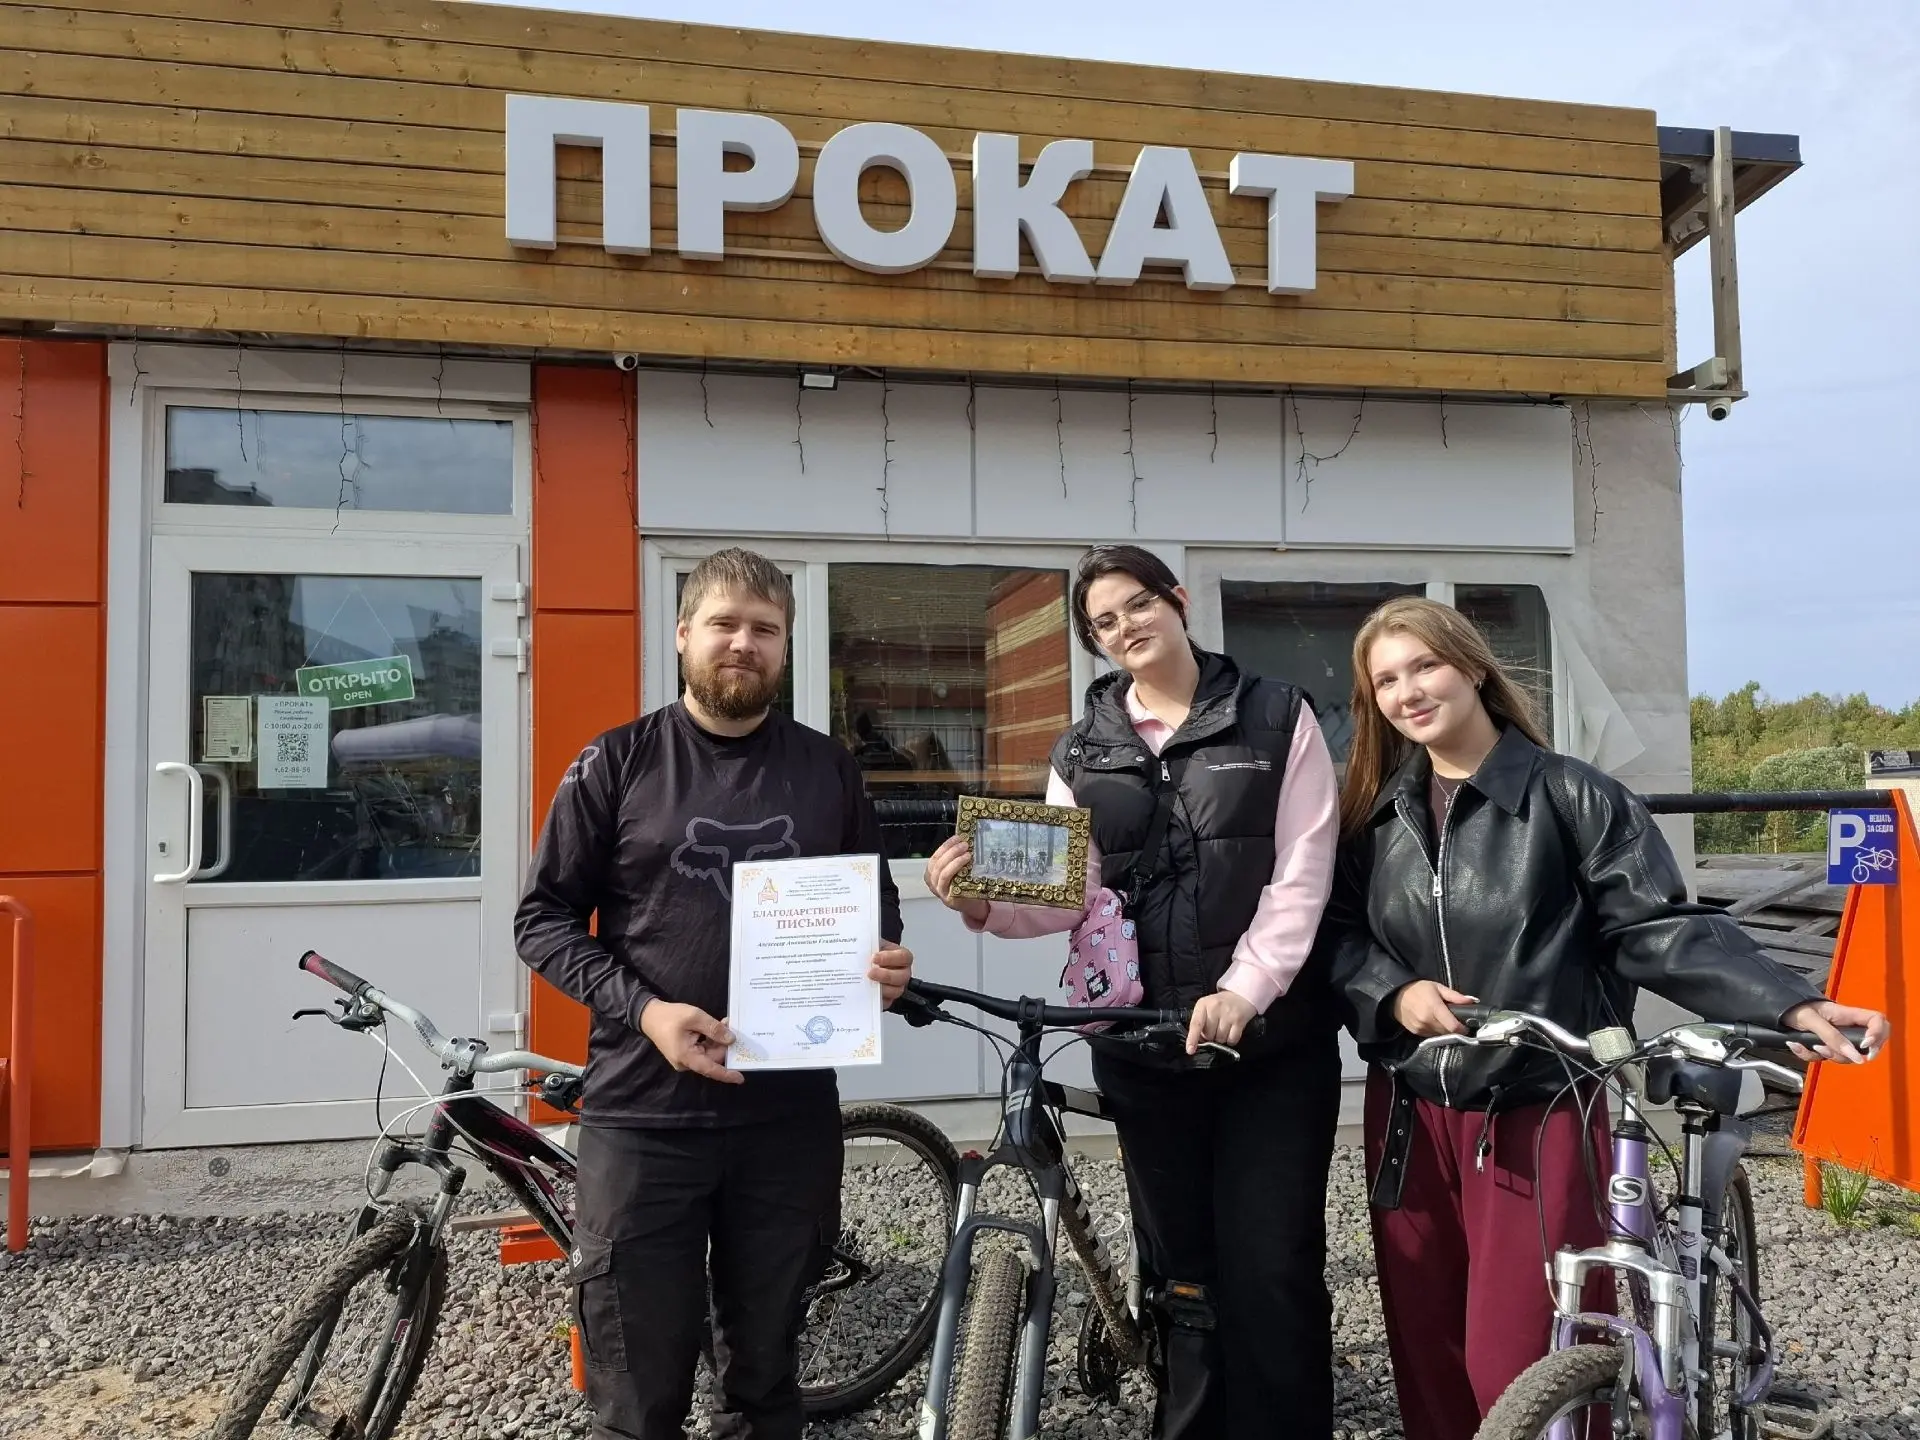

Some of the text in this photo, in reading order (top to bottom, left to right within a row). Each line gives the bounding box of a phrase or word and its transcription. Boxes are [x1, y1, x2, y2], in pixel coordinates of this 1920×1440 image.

[505, 93, 1355, 296] ПРОКАТ
[308, 668, 401, 693] ОТКРЫТО
[343, 689, 373, 701] OPEN
[1869, 814, 1892, 823] ВЕШАТЬ
[1867, 824, 1894, 834] ЗА СЕДЛО
[1830, 814, 1866, 866] P
[752, 905, 860, 919] БЛАГОДАРСТВЕННОЕ
[776, 917, 836, 930] ПИСЬМО
